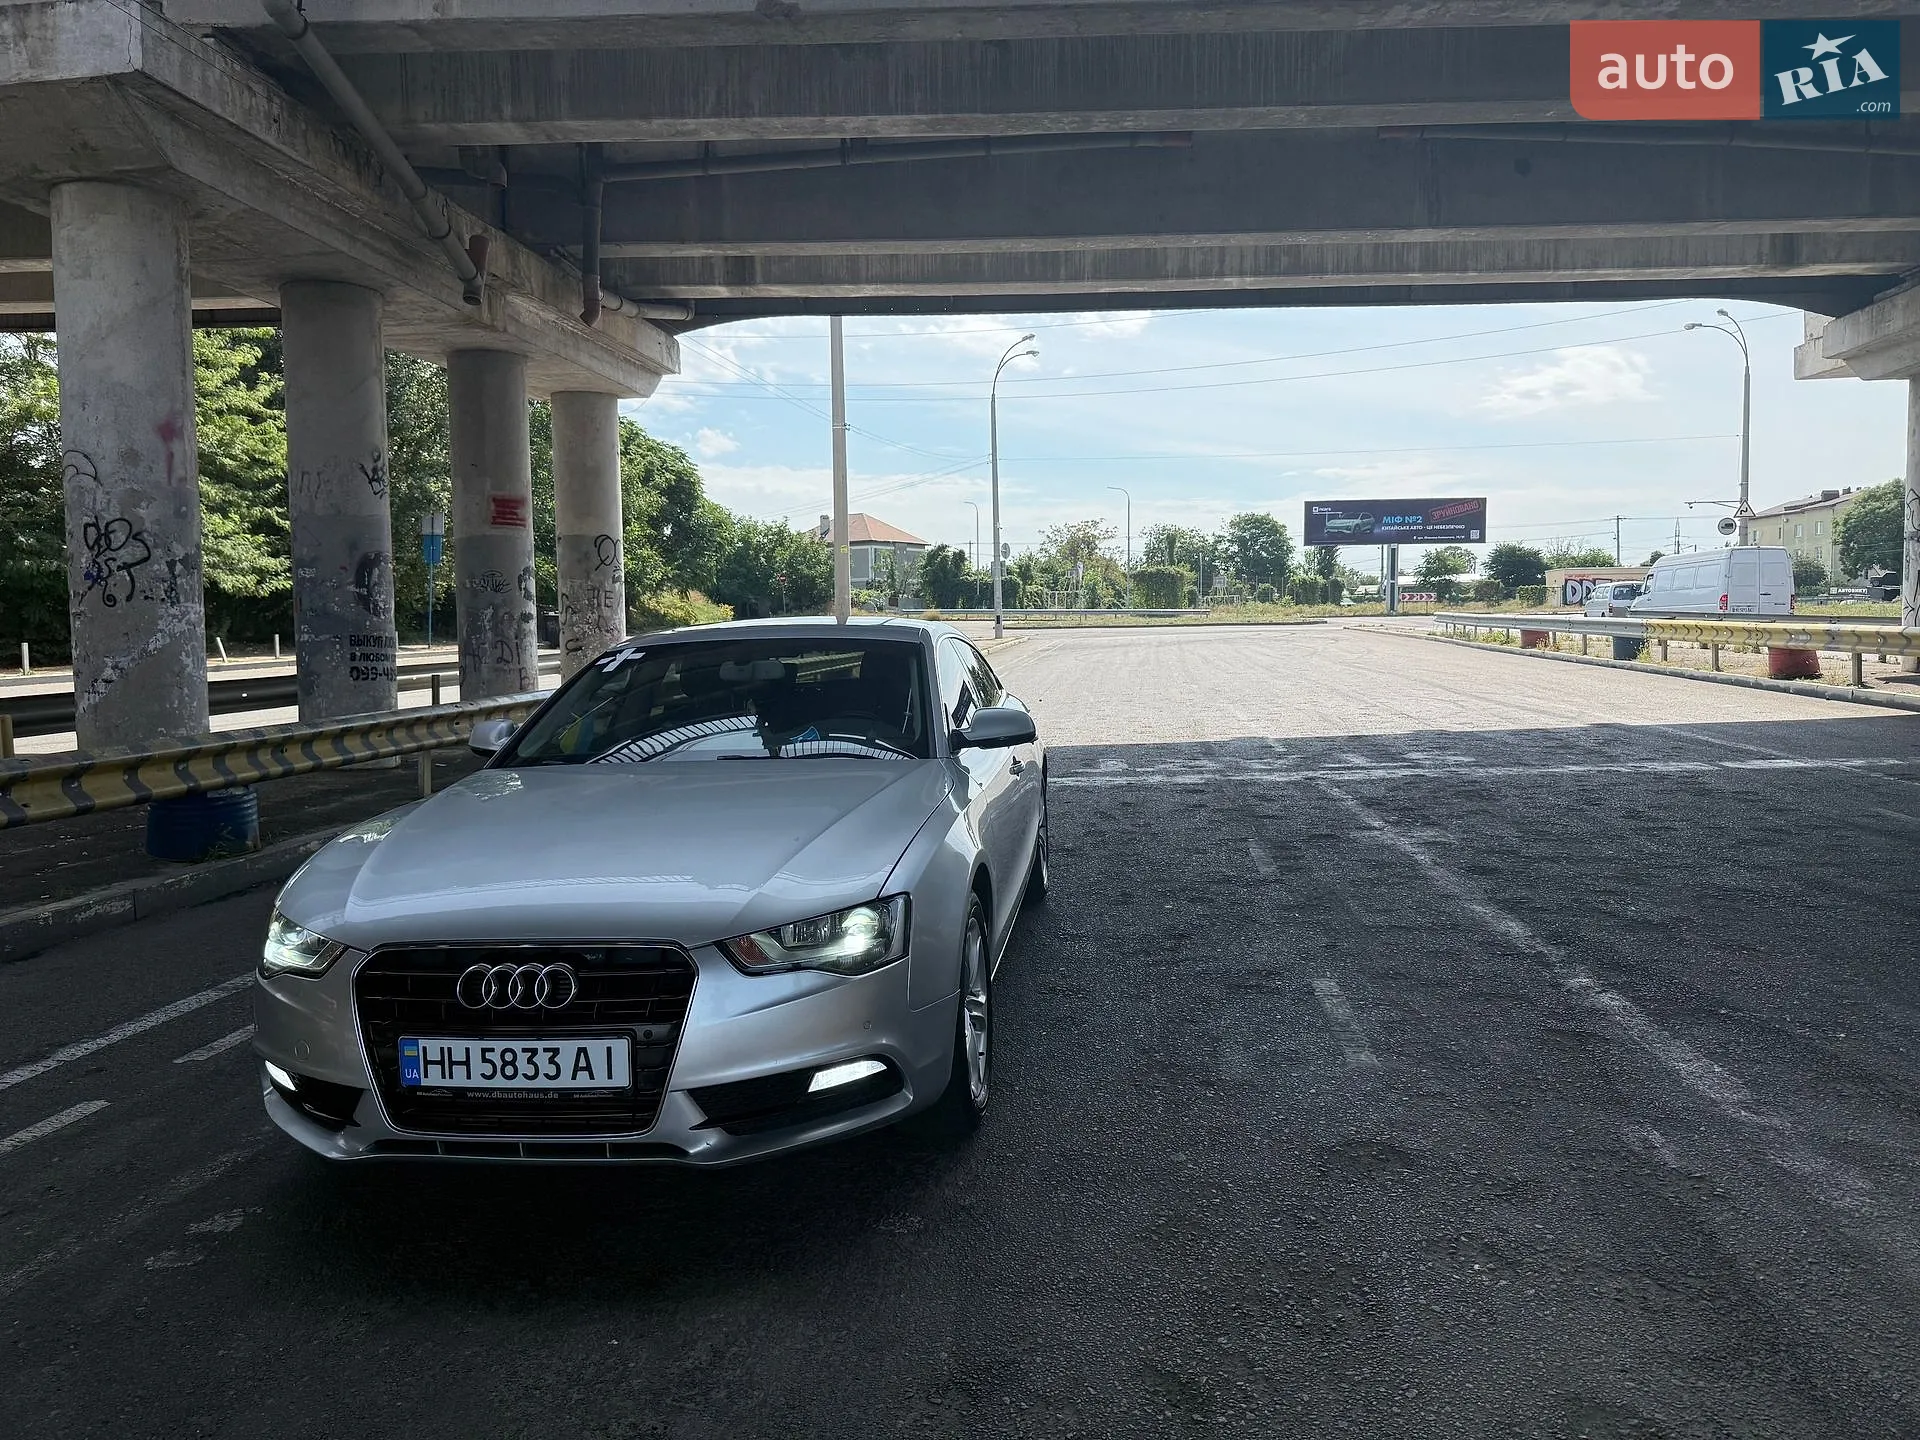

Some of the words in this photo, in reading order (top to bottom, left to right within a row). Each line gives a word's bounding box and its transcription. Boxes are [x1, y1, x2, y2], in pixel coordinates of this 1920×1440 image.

[1431, 501, 1480, 520] ЗРУЙНОВАНО
[1382, 516, 1403, 524] МІФ
[1404, 515, 1422, 524] №2
[349, 634, 383, 648] ВЫКУП
[422, 1046, 472, 1080] HH
[480, 1047, 562, 1081] 5833
[571, 1046, 613, 1080] AI
[405, 1069, 420, 1079] UA
[466, 1091, 559, 1099] www.dbautohaus.de
